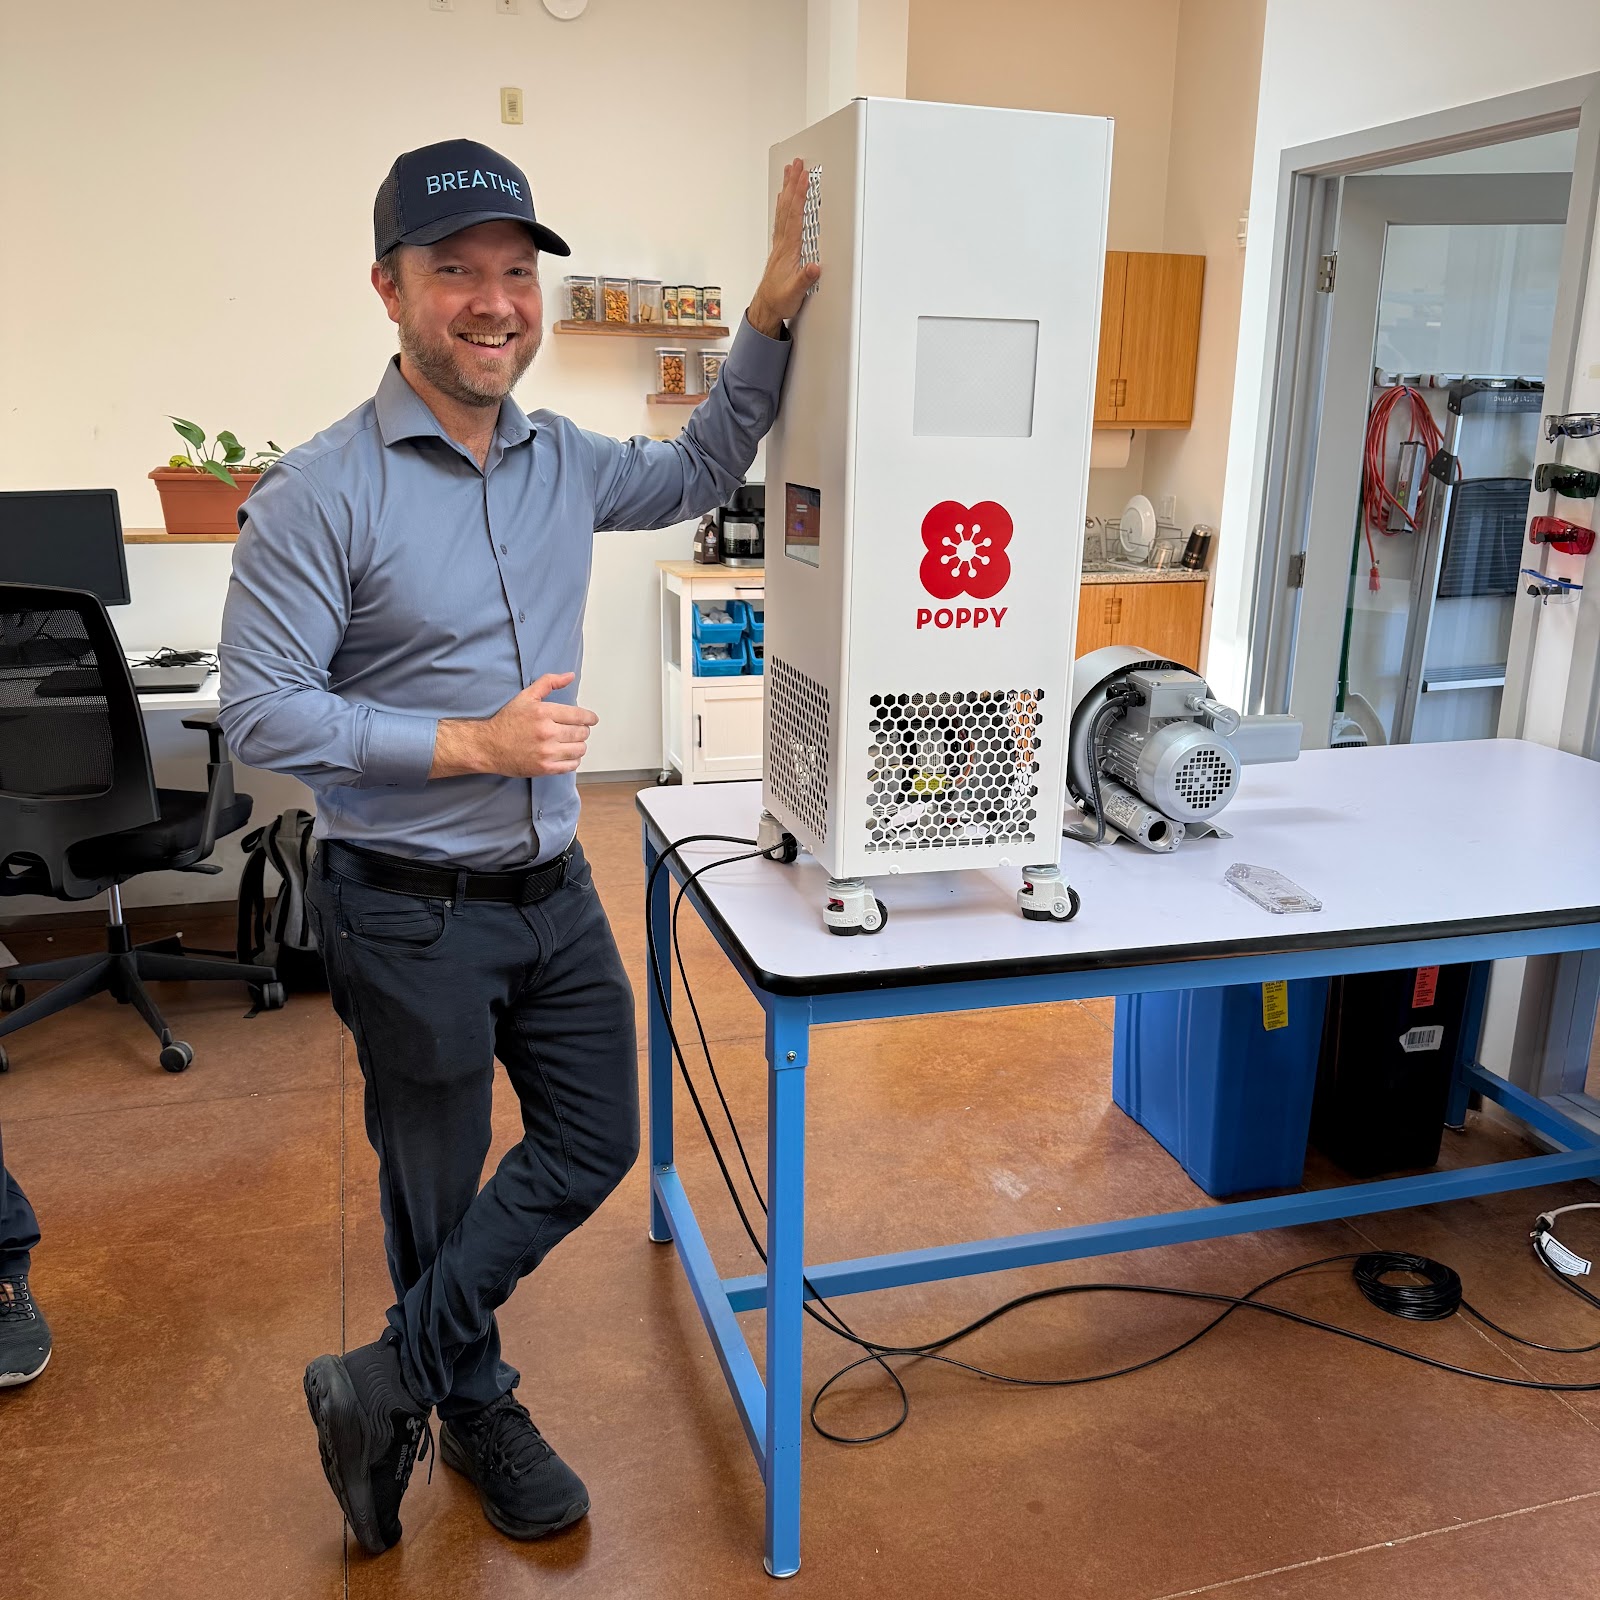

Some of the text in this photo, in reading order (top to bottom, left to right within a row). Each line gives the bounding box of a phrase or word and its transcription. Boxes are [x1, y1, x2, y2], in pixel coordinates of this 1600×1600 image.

[426, 169, 523, 202] BREATHE
[916, 606, 1009, 630] POPPY
[395, 1444, 409, 1481] BROOKS
